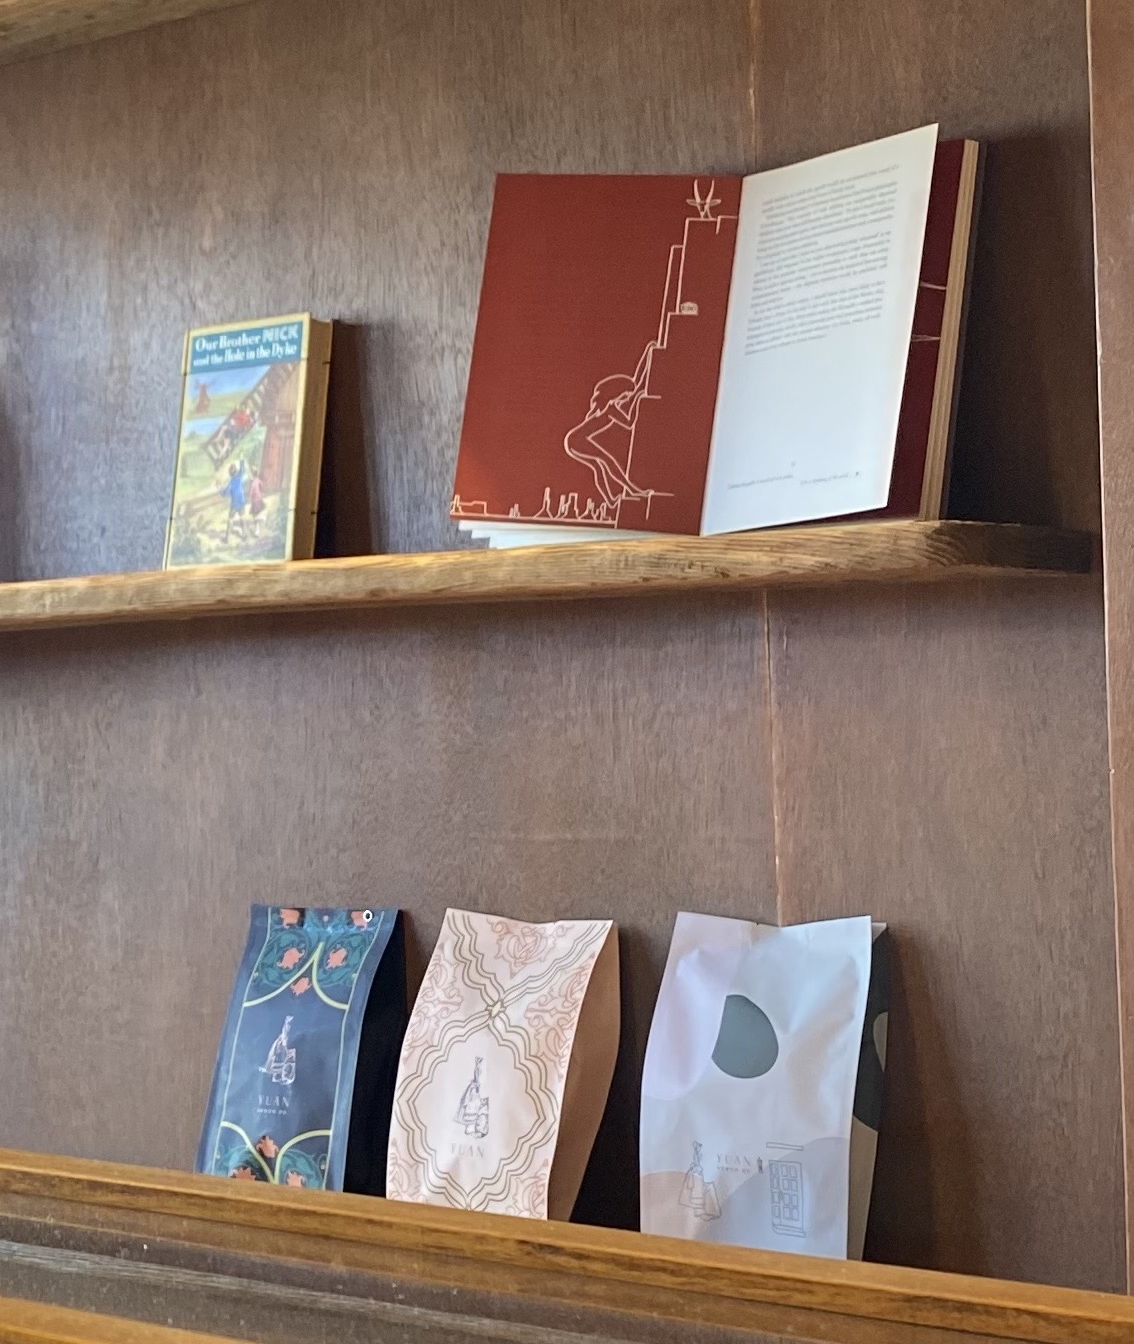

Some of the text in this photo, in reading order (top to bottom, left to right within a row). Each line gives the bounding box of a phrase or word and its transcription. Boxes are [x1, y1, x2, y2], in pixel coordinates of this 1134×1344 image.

[195, 337, 218, 353] Our
[219, 332, 261, 349] Brother
[193, 342, 297, 366] and the Hole in the Dyke
